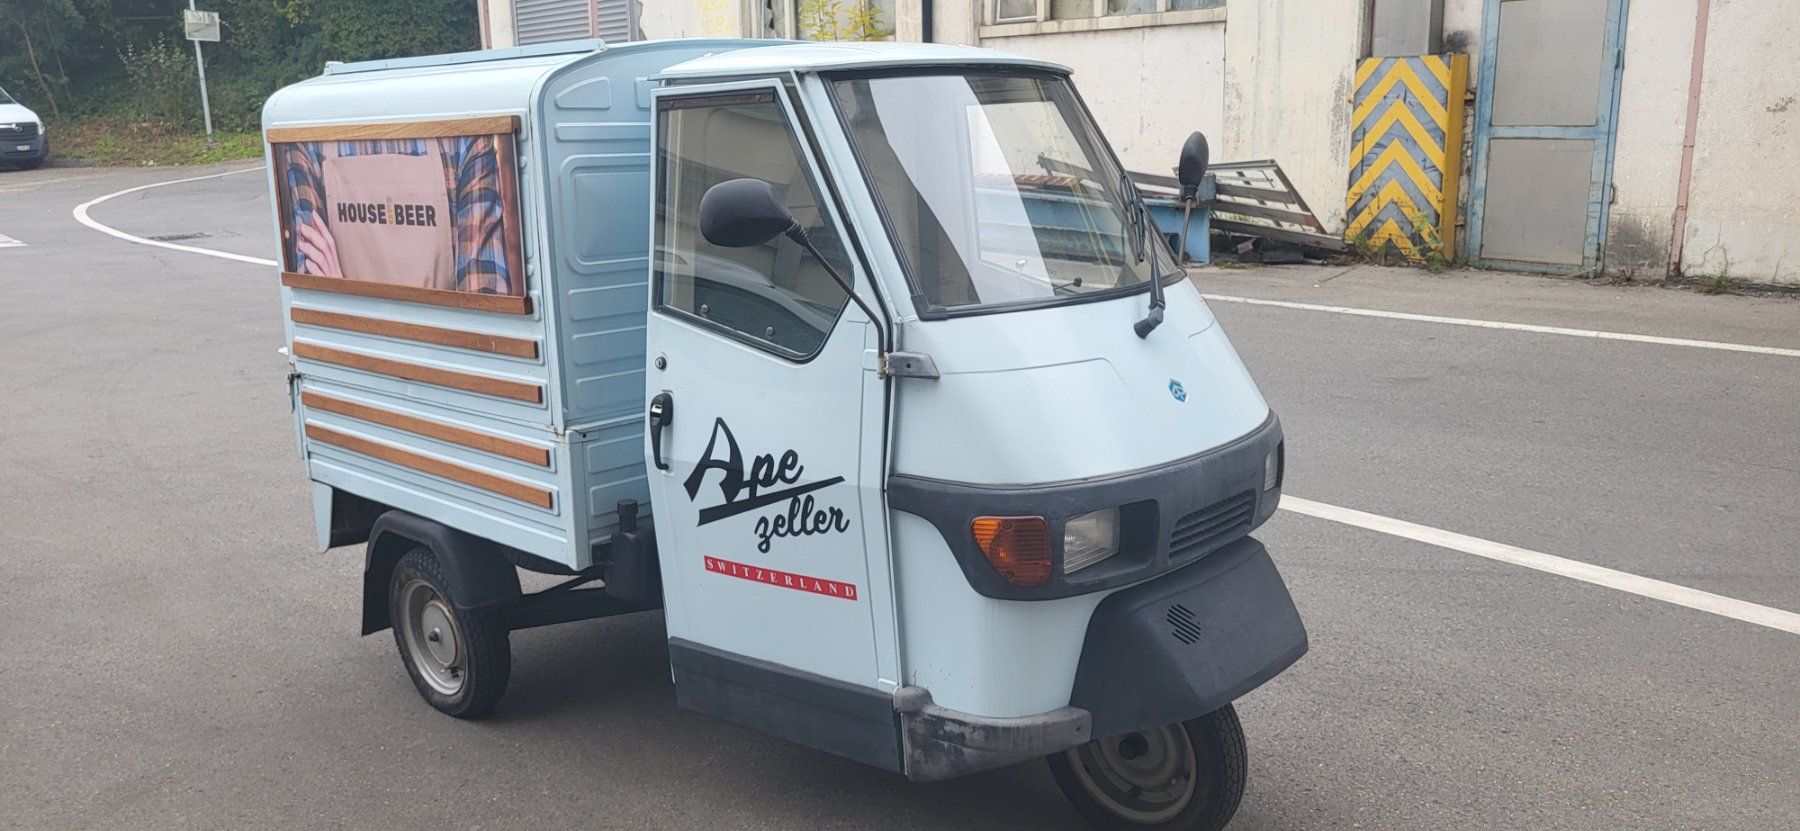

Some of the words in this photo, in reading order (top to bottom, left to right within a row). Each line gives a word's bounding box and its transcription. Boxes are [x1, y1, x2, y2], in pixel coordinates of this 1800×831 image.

[337, 202, 387, 225] HOUSE
[394, 204, 437, 227] BEER
[683, 417, 804, 503] Ape
[754, 494, 850, 554] zeller
[706, 558, 854, 598] SWITZERLAND
